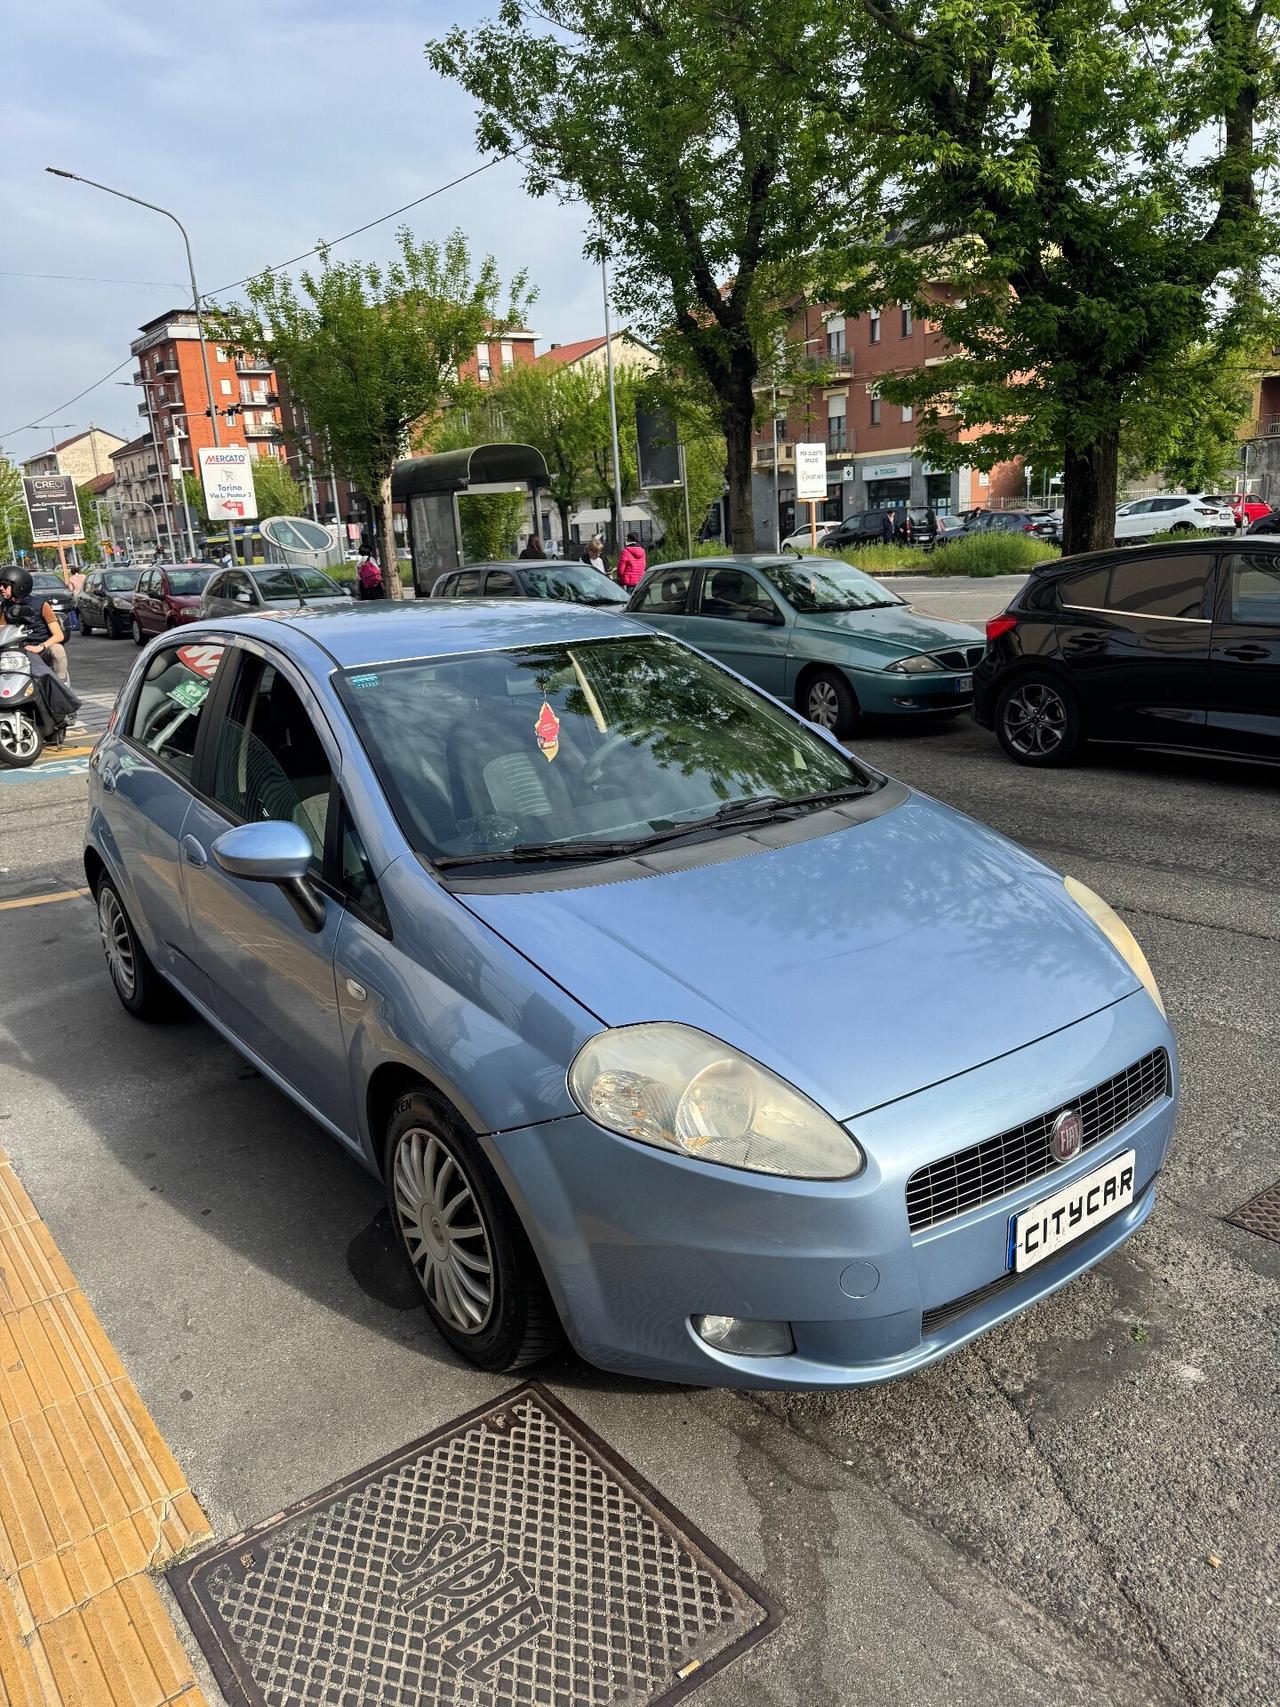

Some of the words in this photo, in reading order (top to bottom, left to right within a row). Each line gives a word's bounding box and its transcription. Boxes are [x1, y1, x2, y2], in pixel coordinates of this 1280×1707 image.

[34, 480, 63, 489] CREO
[217, 483, 242, 492] Torino
[1060, 1122, 1079, 1153] FIAT
[1025, 1166, 1133, 1255] CITYCAR
